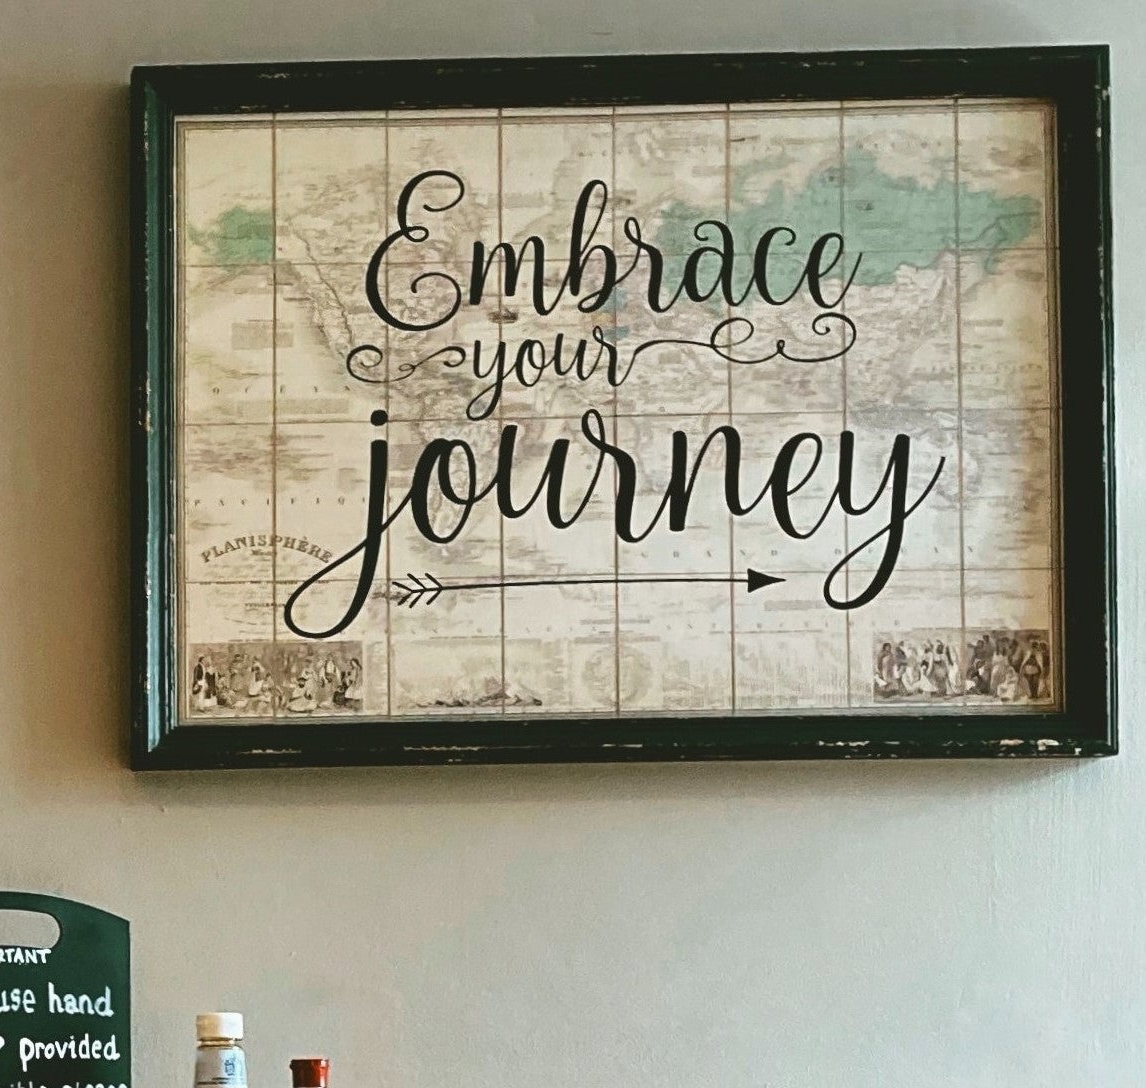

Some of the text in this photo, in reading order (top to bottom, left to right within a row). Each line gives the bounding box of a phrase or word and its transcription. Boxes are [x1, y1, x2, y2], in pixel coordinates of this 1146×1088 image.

[365, 170, 863, 332] Embrace
[283, 408, 946, 639] journey
[199, 533, 334, 564] PLANISPHÈRE
[48, 981, 115, 1018] hand
[19, 1033, 121, 1073] provided
